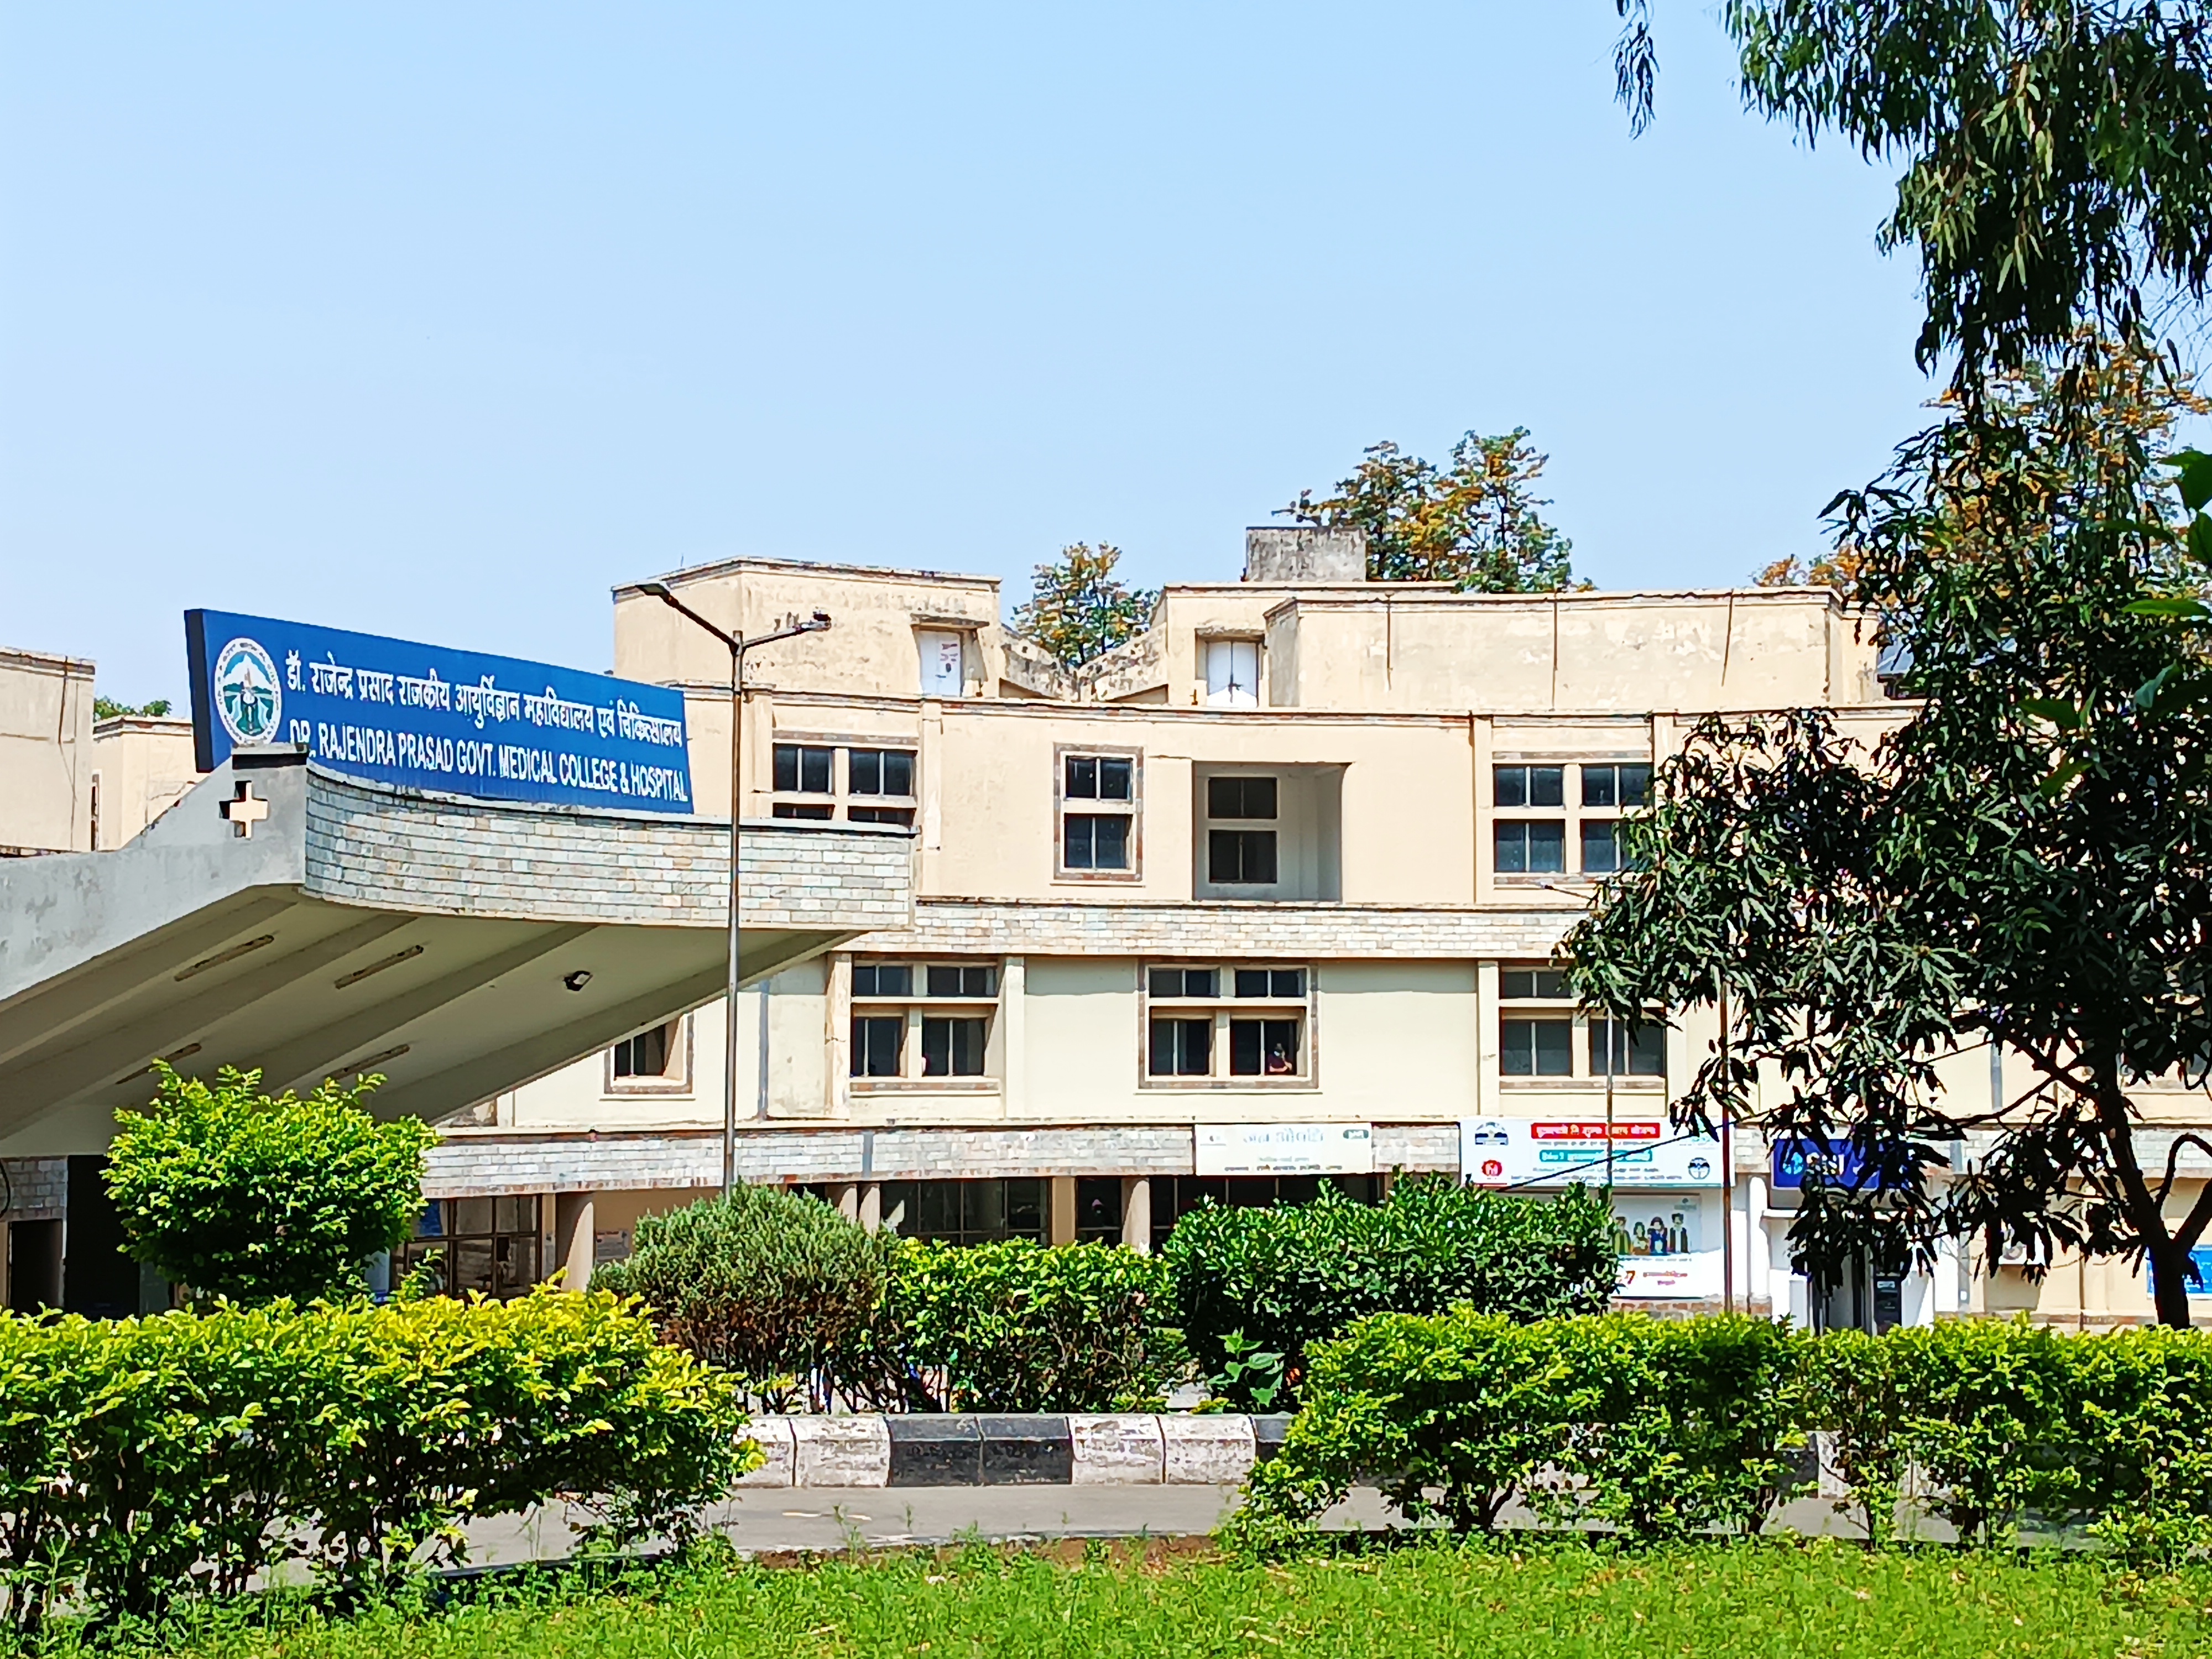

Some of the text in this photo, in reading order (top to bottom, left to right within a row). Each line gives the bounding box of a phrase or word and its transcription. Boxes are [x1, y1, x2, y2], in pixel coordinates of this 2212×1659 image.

[285, 650, 306, 692] डॉ.
[309, 651, 354, 701] राजेन्द्र
[356, 669, 394, 707] प्रसाद
[396, 667, 451, 712] राजकीय
[455, 675, 520, 729] आयुर्विज्ञान
[523, 685, 594, 733] महाविद्यालय
[596, 699, 615, 738] एवं
[617, 697, 682, 748] चिकित्सालय
[318, 722, 396, 767] RAJENDRA
[397, 732, 454, 773] PRASAD
[456, 739, 496, 777] GOVT.
[499, 744, 558, 784] MEDICAL
[559, 753, 618, 792] COLLEGE
[619, 761, 630, 794] &
[630, 761, 688, 802] HOSPITAL
